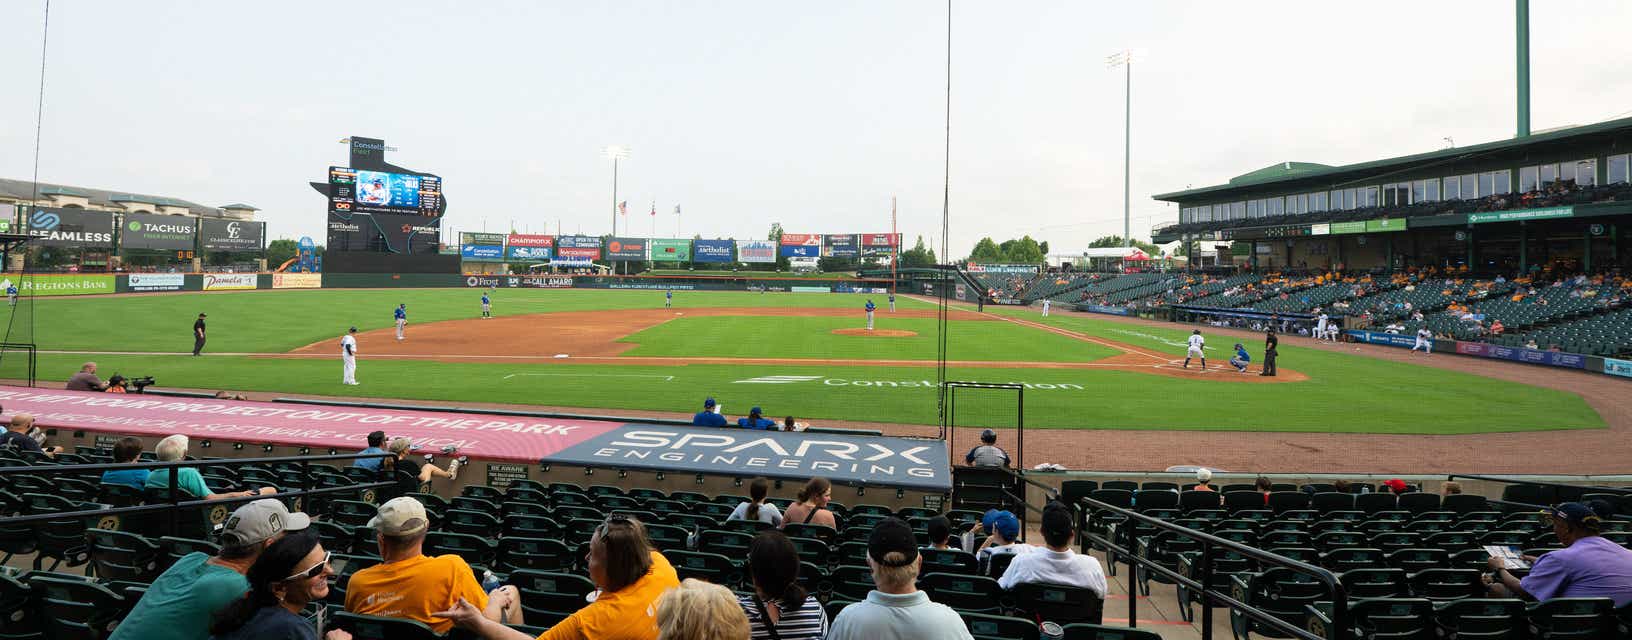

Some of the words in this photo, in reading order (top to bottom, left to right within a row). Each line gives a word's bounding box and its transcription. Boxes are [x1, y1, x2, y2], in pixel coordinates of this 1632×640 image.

[144, 224, 191, 234] TACHUS
[698, 244, 730, 253] Methodist
[23, 281, 81, 291] REGIONS
[70, 396, 164, 409] YOUR
[148, 401, 297, 416] PROJECT
[285, 409, 369, 421] OUT
[358, 414, 416, 424] OF
[410, 417, 483, 429] THE
[475, 421, 581, 435] PARK
[609, 430, 931, 465] SPARX
[592, 448, 936, 478] ENGINEERING
